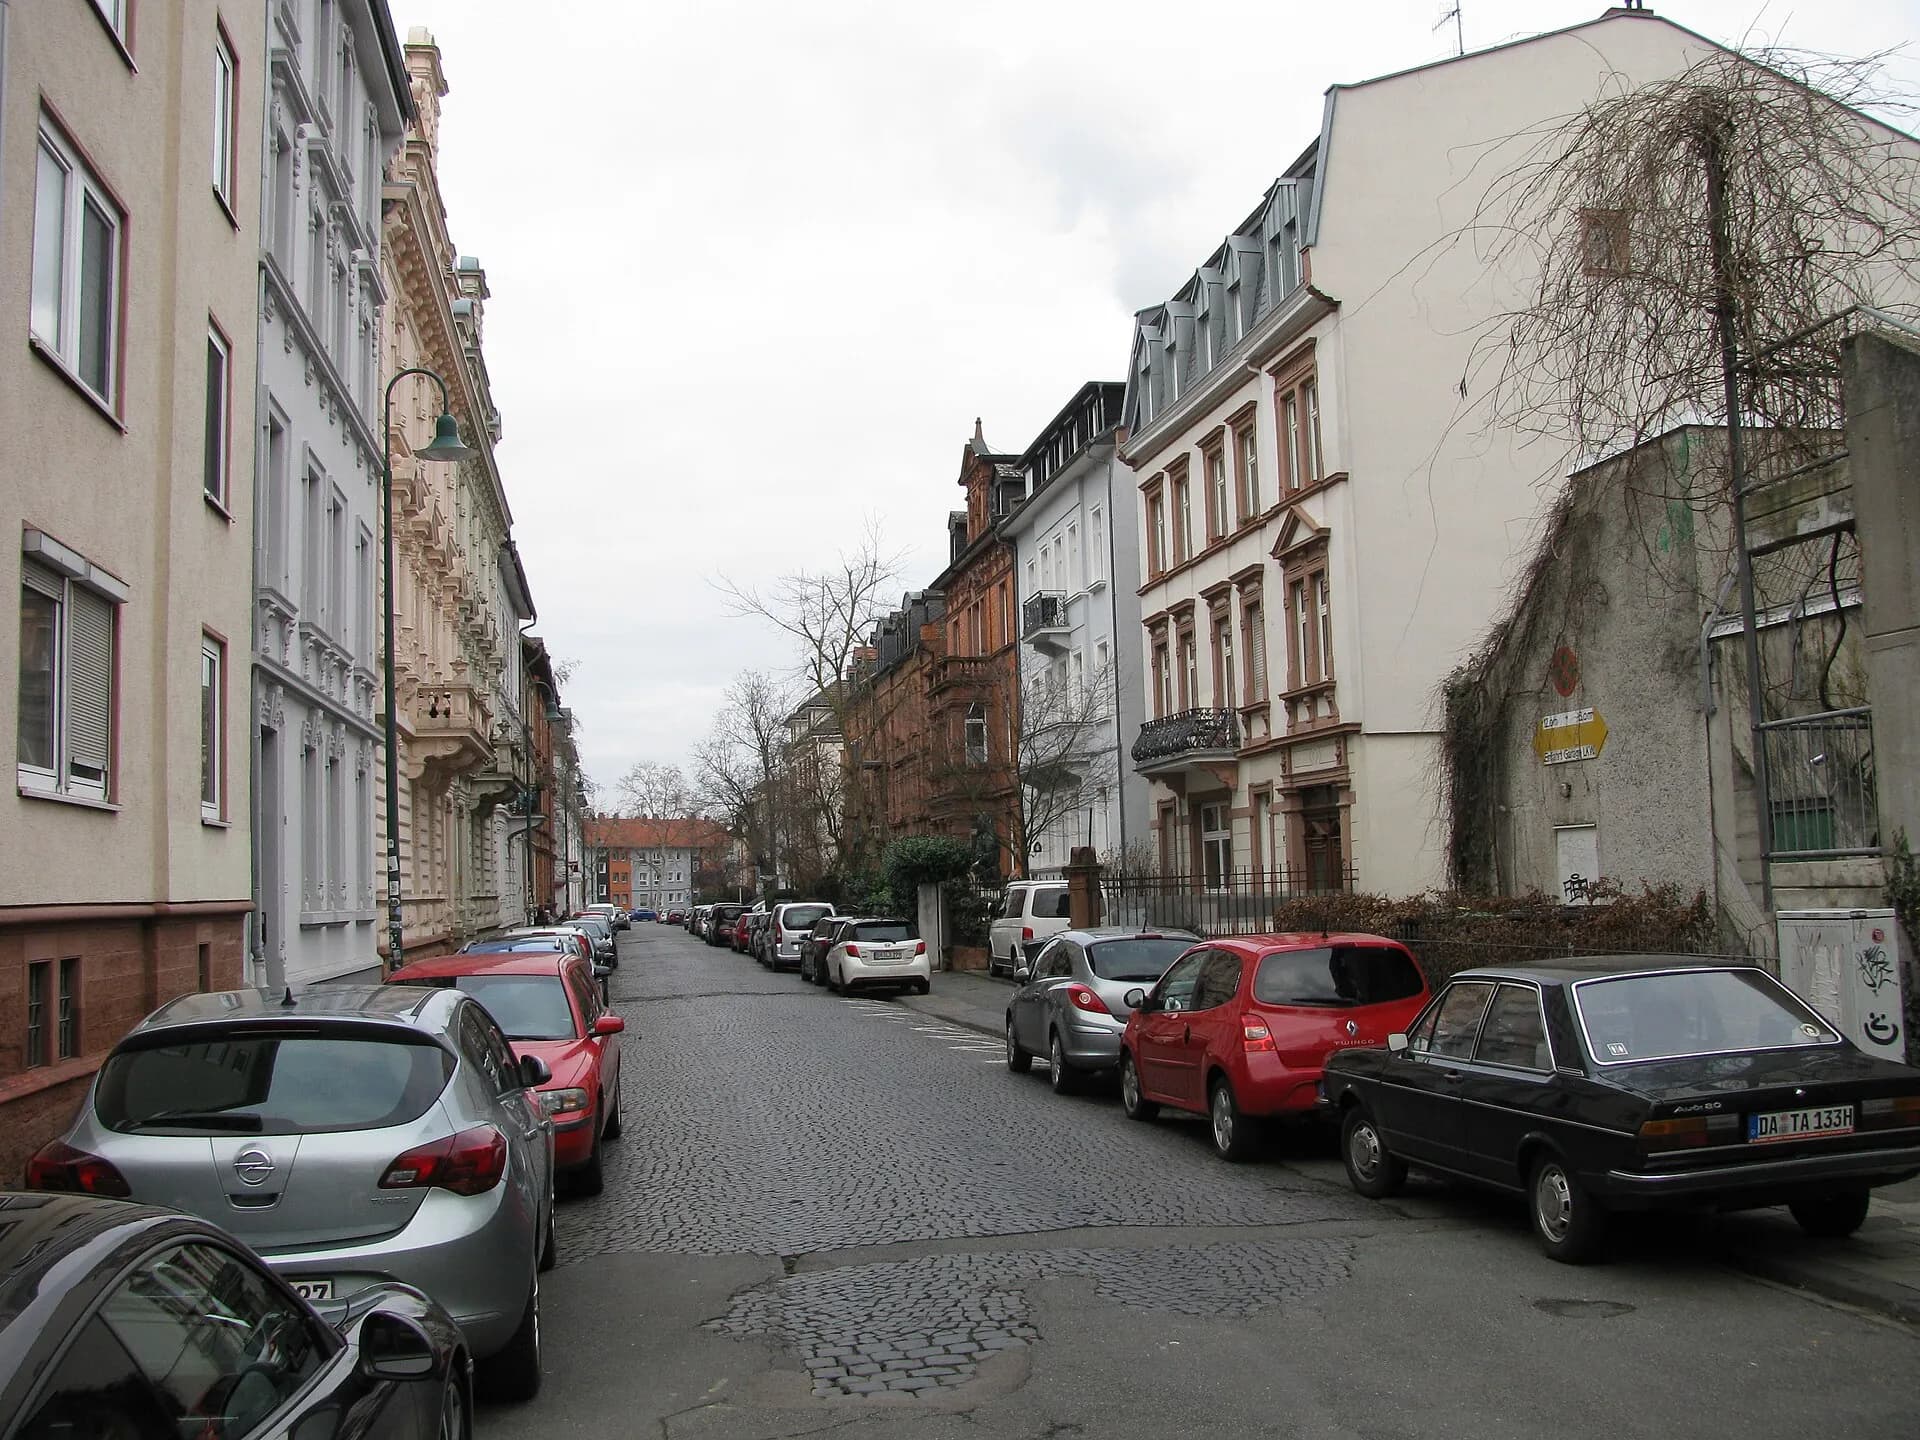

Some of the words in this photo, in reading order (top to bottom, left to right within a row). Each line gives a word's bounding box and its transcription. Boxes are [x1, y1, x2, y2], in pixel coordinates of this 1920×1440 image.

[1759, 1116, 1778, 1135] DA
[1790, 1112, 1810, 1132] TA
[1813, 1107, 1853, 1130] 133H
